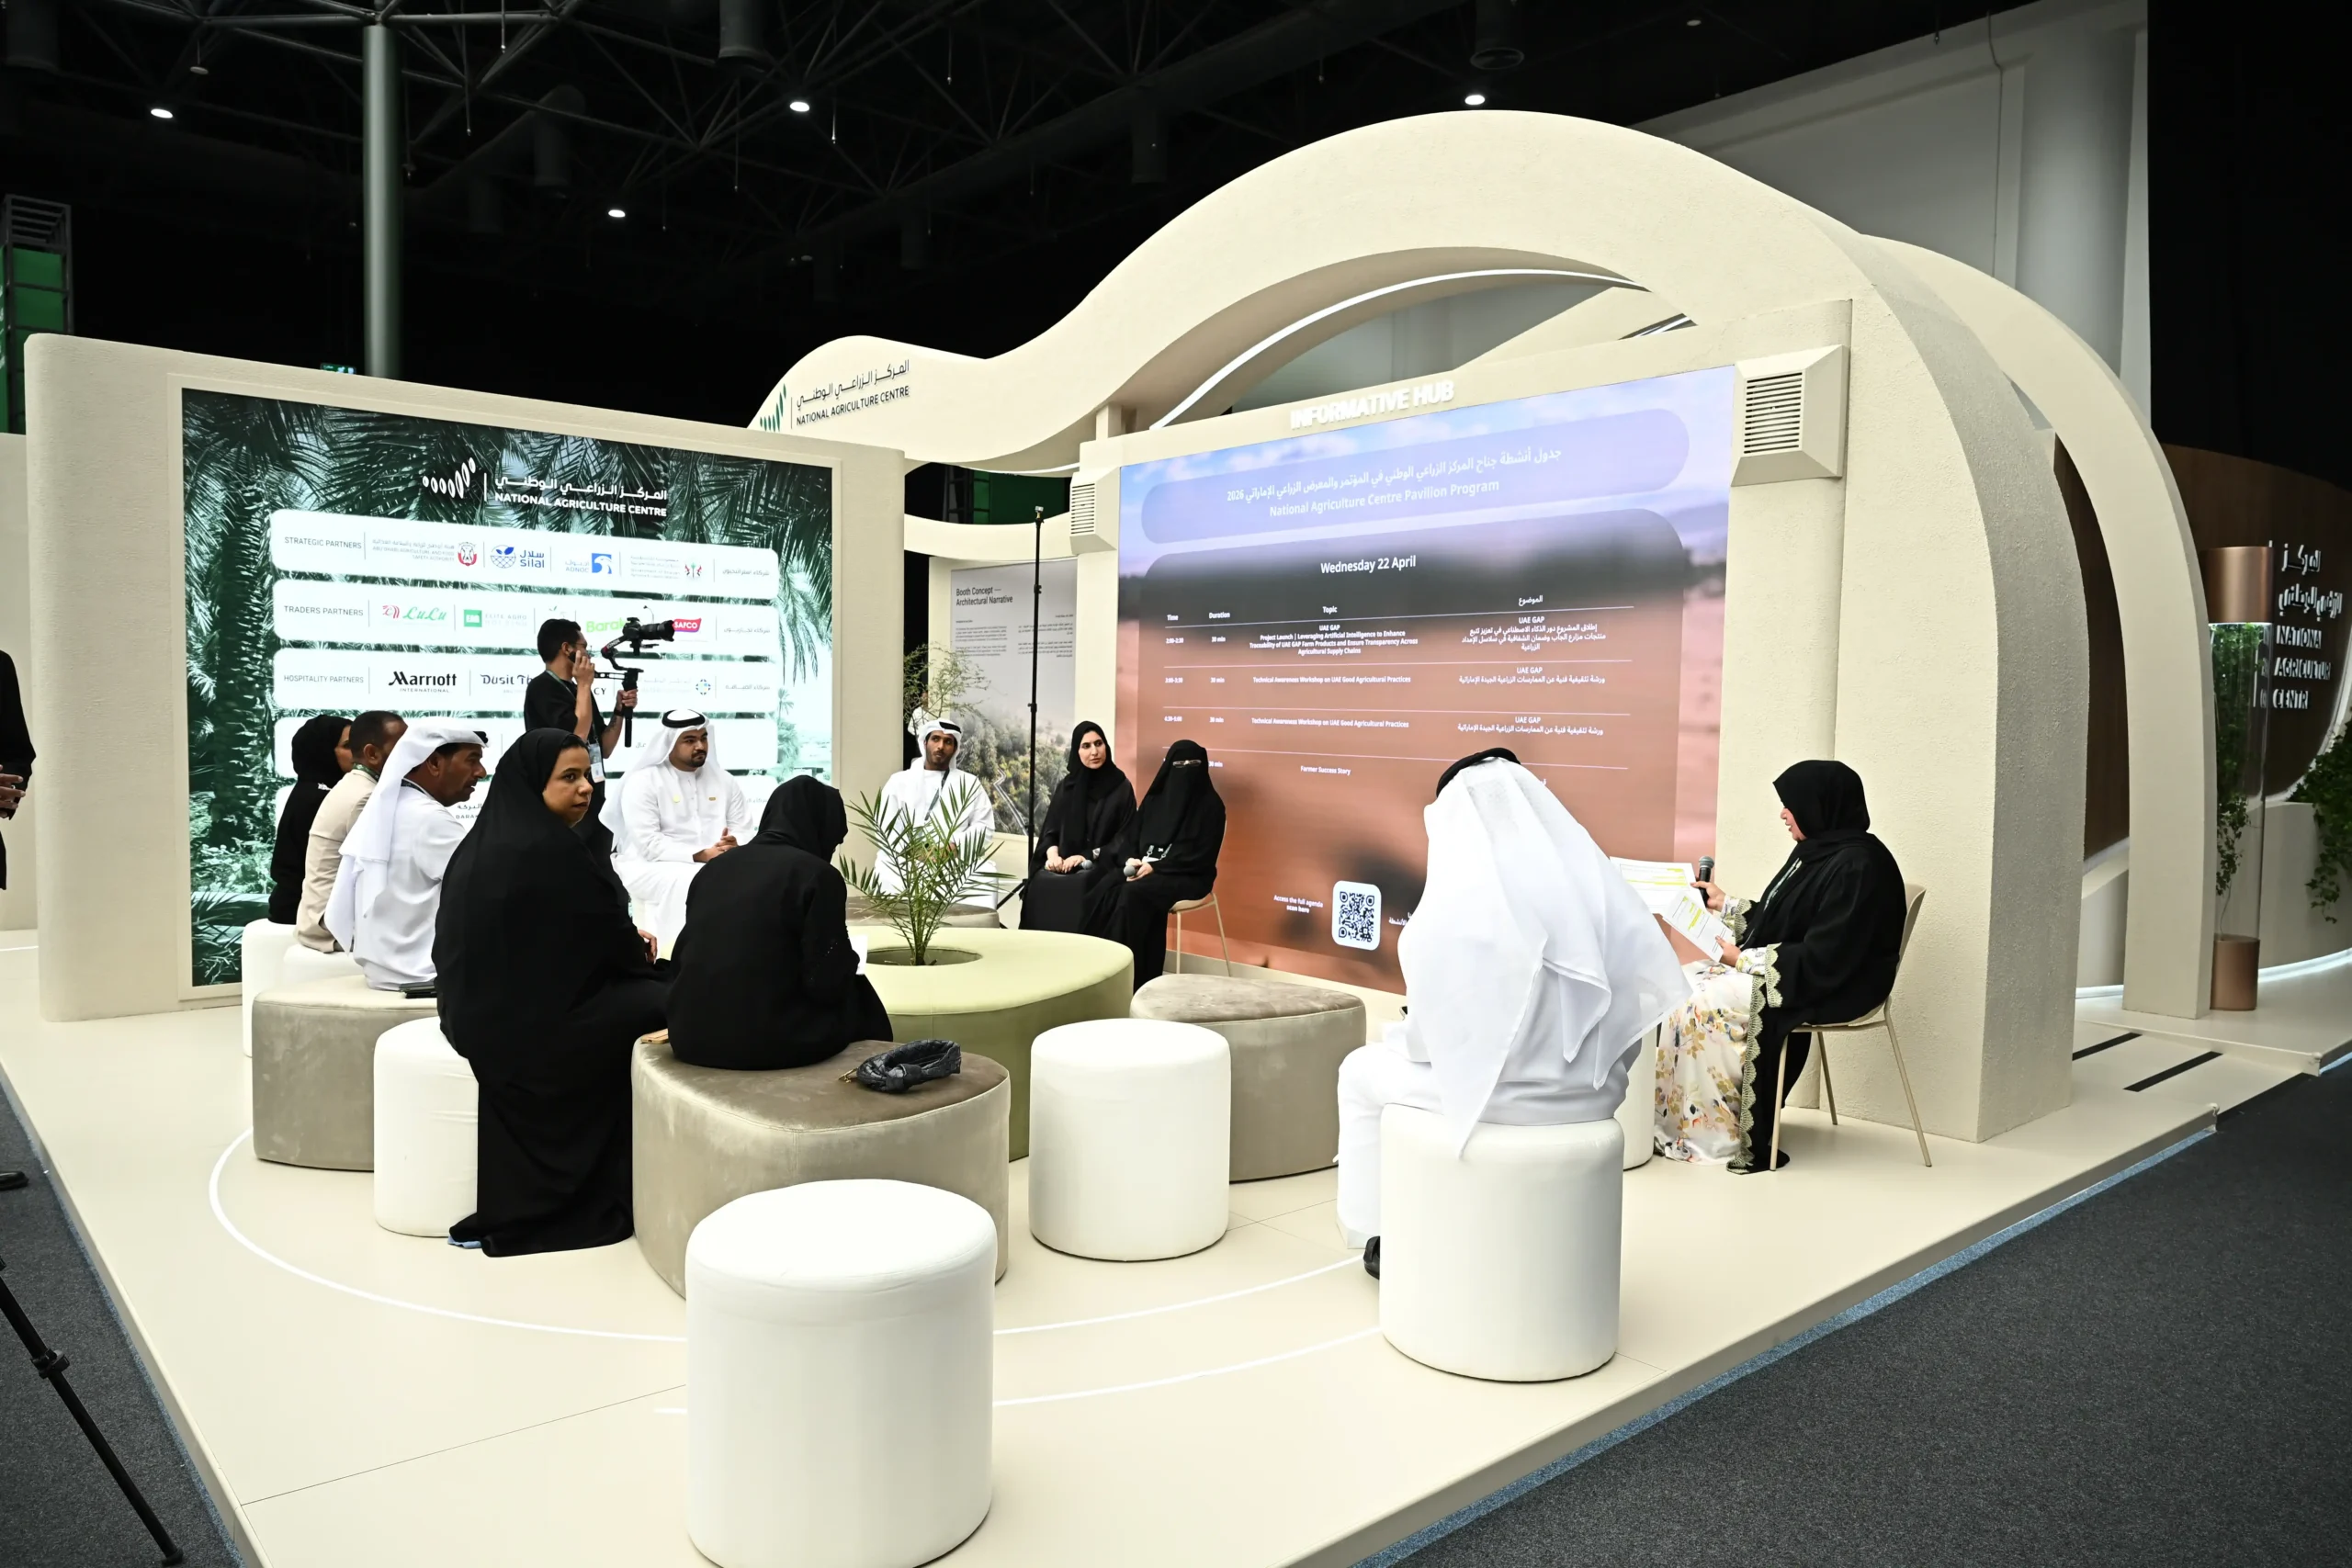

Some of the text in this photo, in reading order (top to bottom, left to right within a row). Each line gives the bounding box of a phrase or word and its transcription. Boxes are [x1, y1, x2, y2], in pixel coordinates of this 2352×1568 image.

[797, 359, 910, 411] المركز الزراعي الوطني
[797, 385, 910, 426] NATIONAL AGRICULTURE CENTRE
[1290, 380, 1454, 429] INFORMATIVE HUB
[1227, 446, 1562, 503] جدول أنشطة جناح المركز الزراعي الوطني في المؤتمر والمعرض الزراعي الإماراتي 2026
[495, 475, 667, 501] المركز الزراعي الوطني
[495, 492, 668, 517] NATIONAL AGRICULTURE CENTRE
[1270, 481, 1499, 516] National Agriculture Centre Pavilion Program
[284, 536, 362, 549] STRATEGIC PARTNERS
[520, 549, 545, 558] سلال
[1320, 555, 1416, 574] Wednesday 22 April
[956, 587, 993, 596] Booth Concept
[956, 595, 1013, 606] Architectural Narrative
[1518, 594, 1544, 607] الموضوع
[284, 605, 364, 616] TRADERS PARTNERS
[1322, 606, 1338, 615] Topic
[586, 617, 627, 633] Barak
[673, 621, 698, 629] SAFCO
[1260, 634, 1276, 642] Project
[1297, 632, 1324, 640] Leveraging
[1325, 631, 1345, 639] Artificial
[1346, 631, 1376, 639] Intelligence
[1364, 638, 1400, 647] Transparency
[284, 674, 328, 682] HOSPITALITY
[388, 671, 457, 686] Marriott
[480, 673, 515, 685] Dusit
[1299, 676, 1323, 684] Workshop
[1355, 676, 1386, 684] Agricultural
[1337, 767, 1351, 776] Story
[1273, 895, 1289, 903] Access
[1306, 899, 1323, 908] agenda
